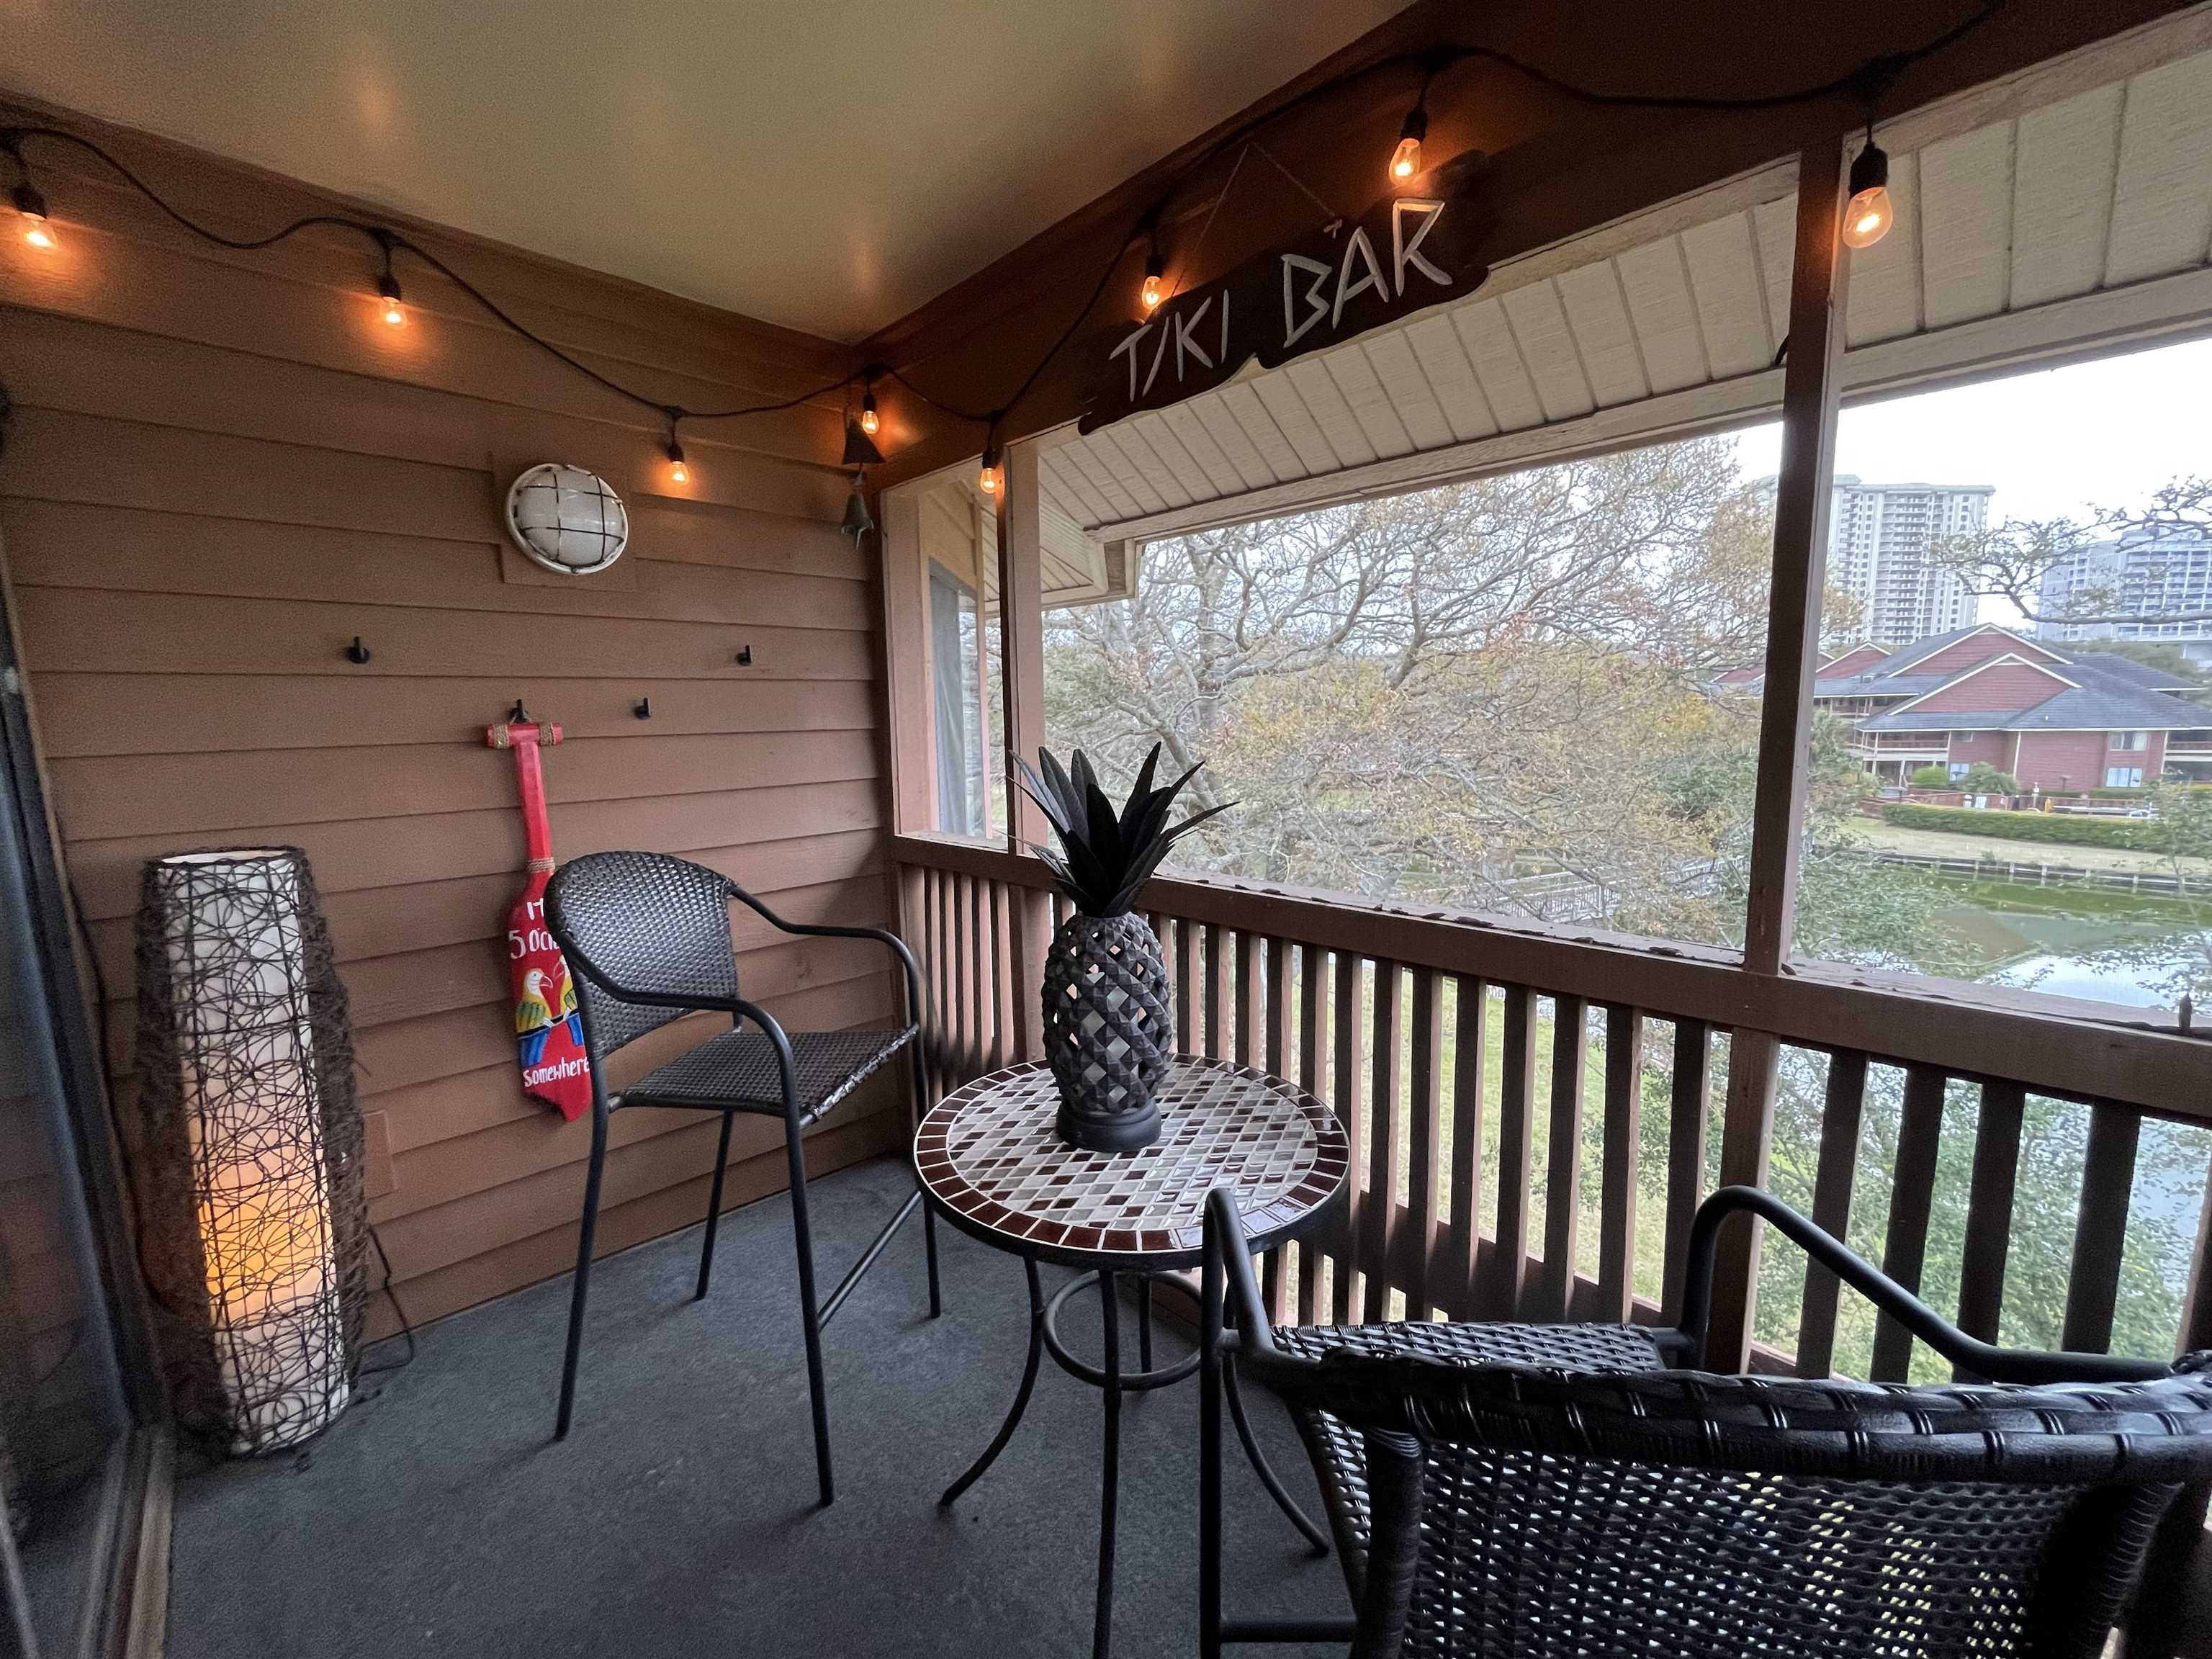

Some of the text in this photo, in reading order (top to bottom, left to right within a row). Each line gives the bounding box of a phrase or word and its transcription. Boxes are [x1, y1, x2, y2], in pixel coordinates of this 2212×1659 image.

[1108, 197, 1453, 402] TIKI BAR
[508, 929, 526, 960] 5
